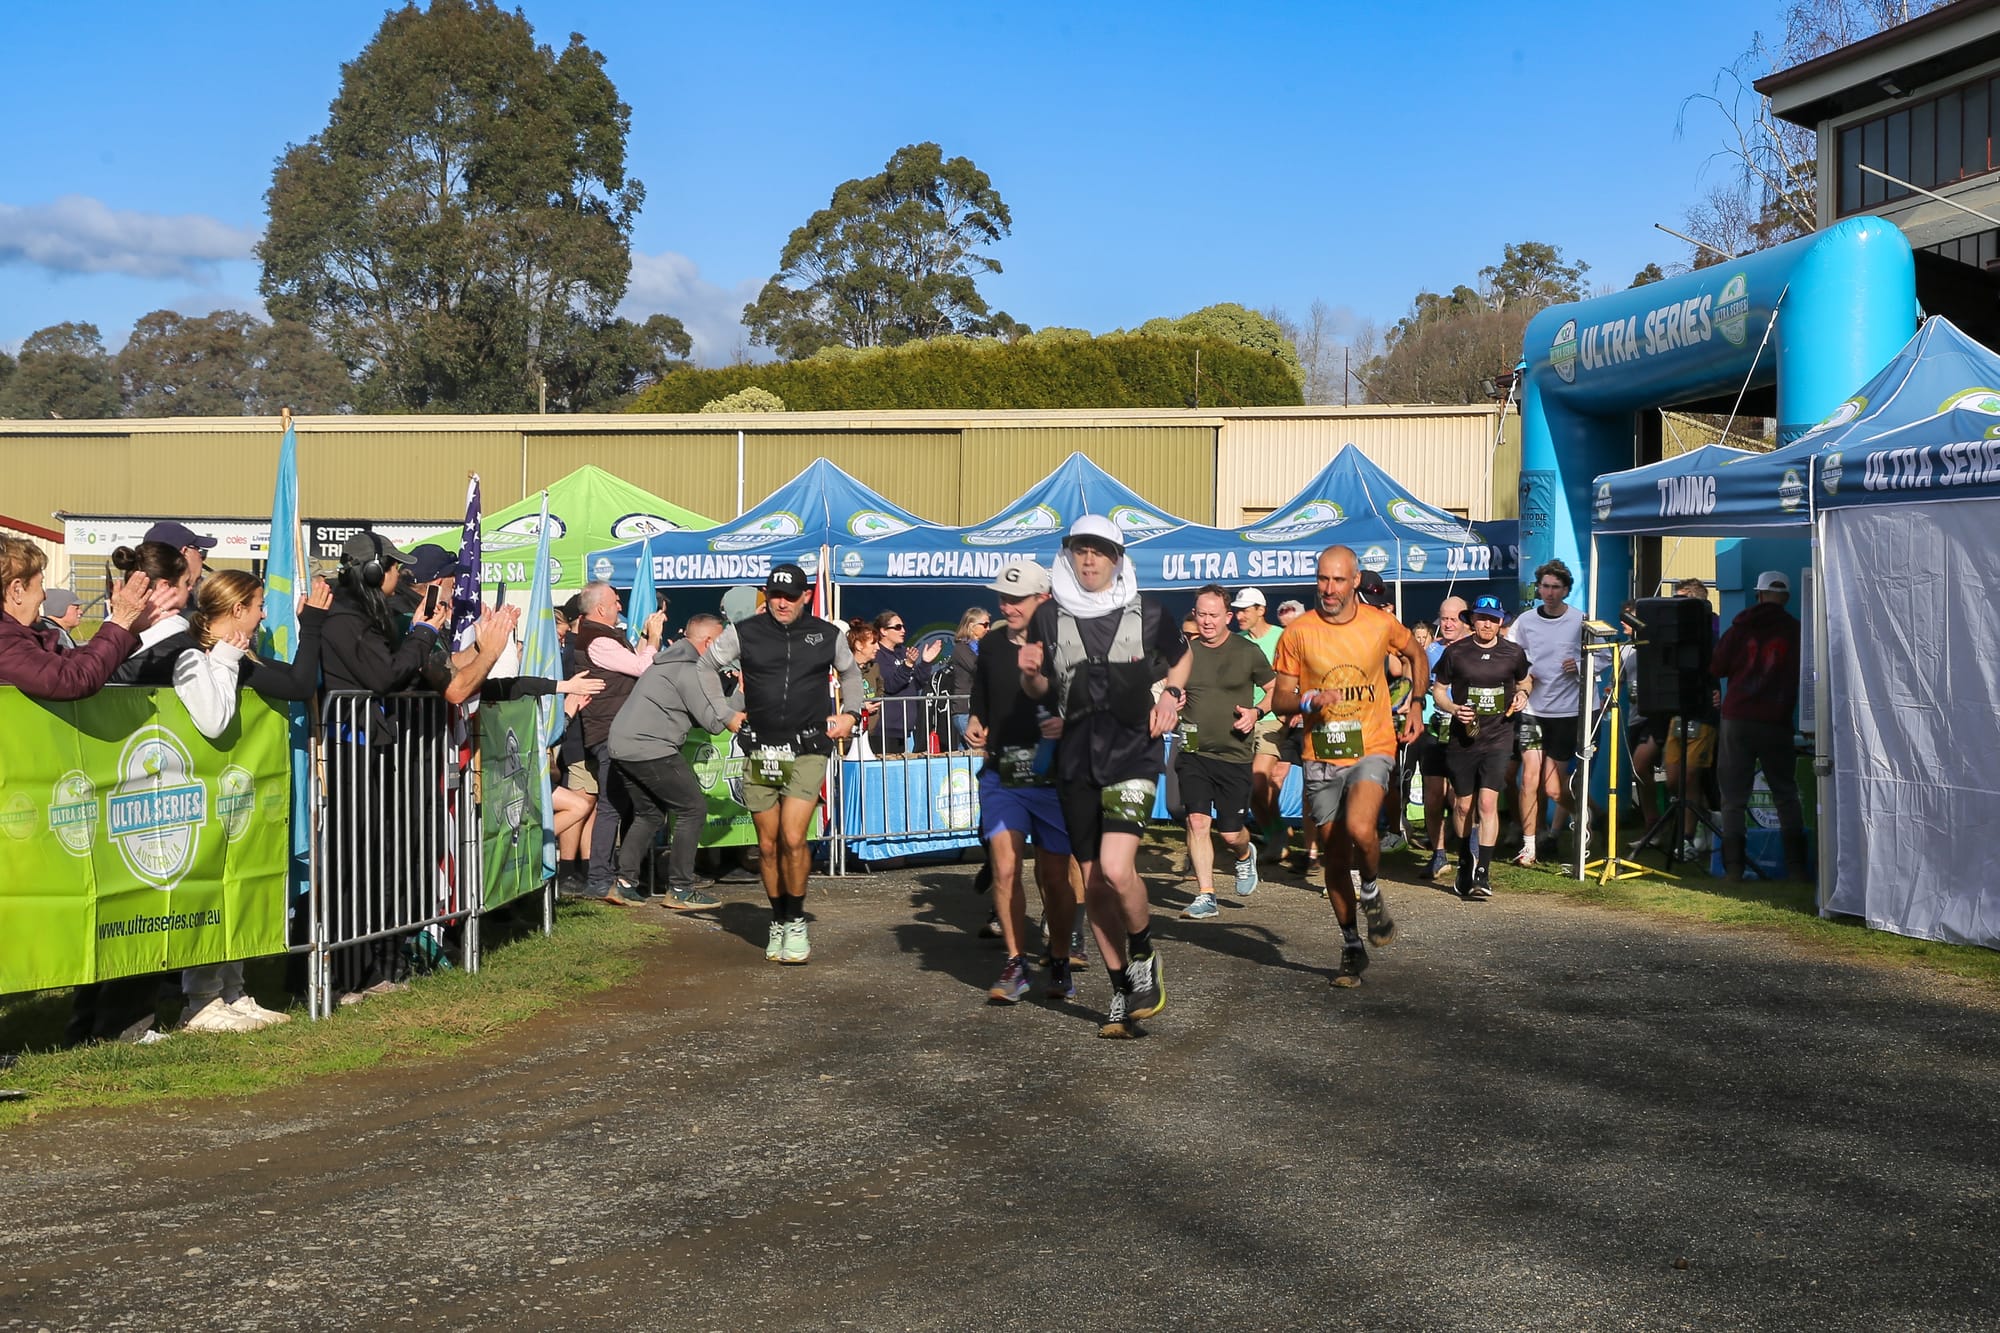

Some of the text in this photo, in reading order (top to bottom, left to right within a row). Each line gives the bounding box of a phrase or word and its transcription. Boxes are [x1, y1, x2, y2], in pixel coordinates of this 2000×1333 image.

[1581, 294, 1712, 371] ULTRA SERIES
[1864, 446, 1933, 491] ULTRA
[1658, 476, 1716, 517] TIMING
[1535, 513, 1547, 521] DIE
[506, 562, 526, 582] SA
[636, 554, 772, 580] ERCHANDISE
[1162, 551, 1239, 580] ULTRA
[1446, 545, 1503, 572] ULTRA
[1005, 568, 1020, 583] G
[762, 760, 779, 770] 2210
[52, 808, 75, 825] ULTRA
[112, 791, 201, 829] ULTRA SERIES
[136, 842, 182, 870] AUSTRALIA
[98, 909, 221, 940] www.ultraseries.com.au
